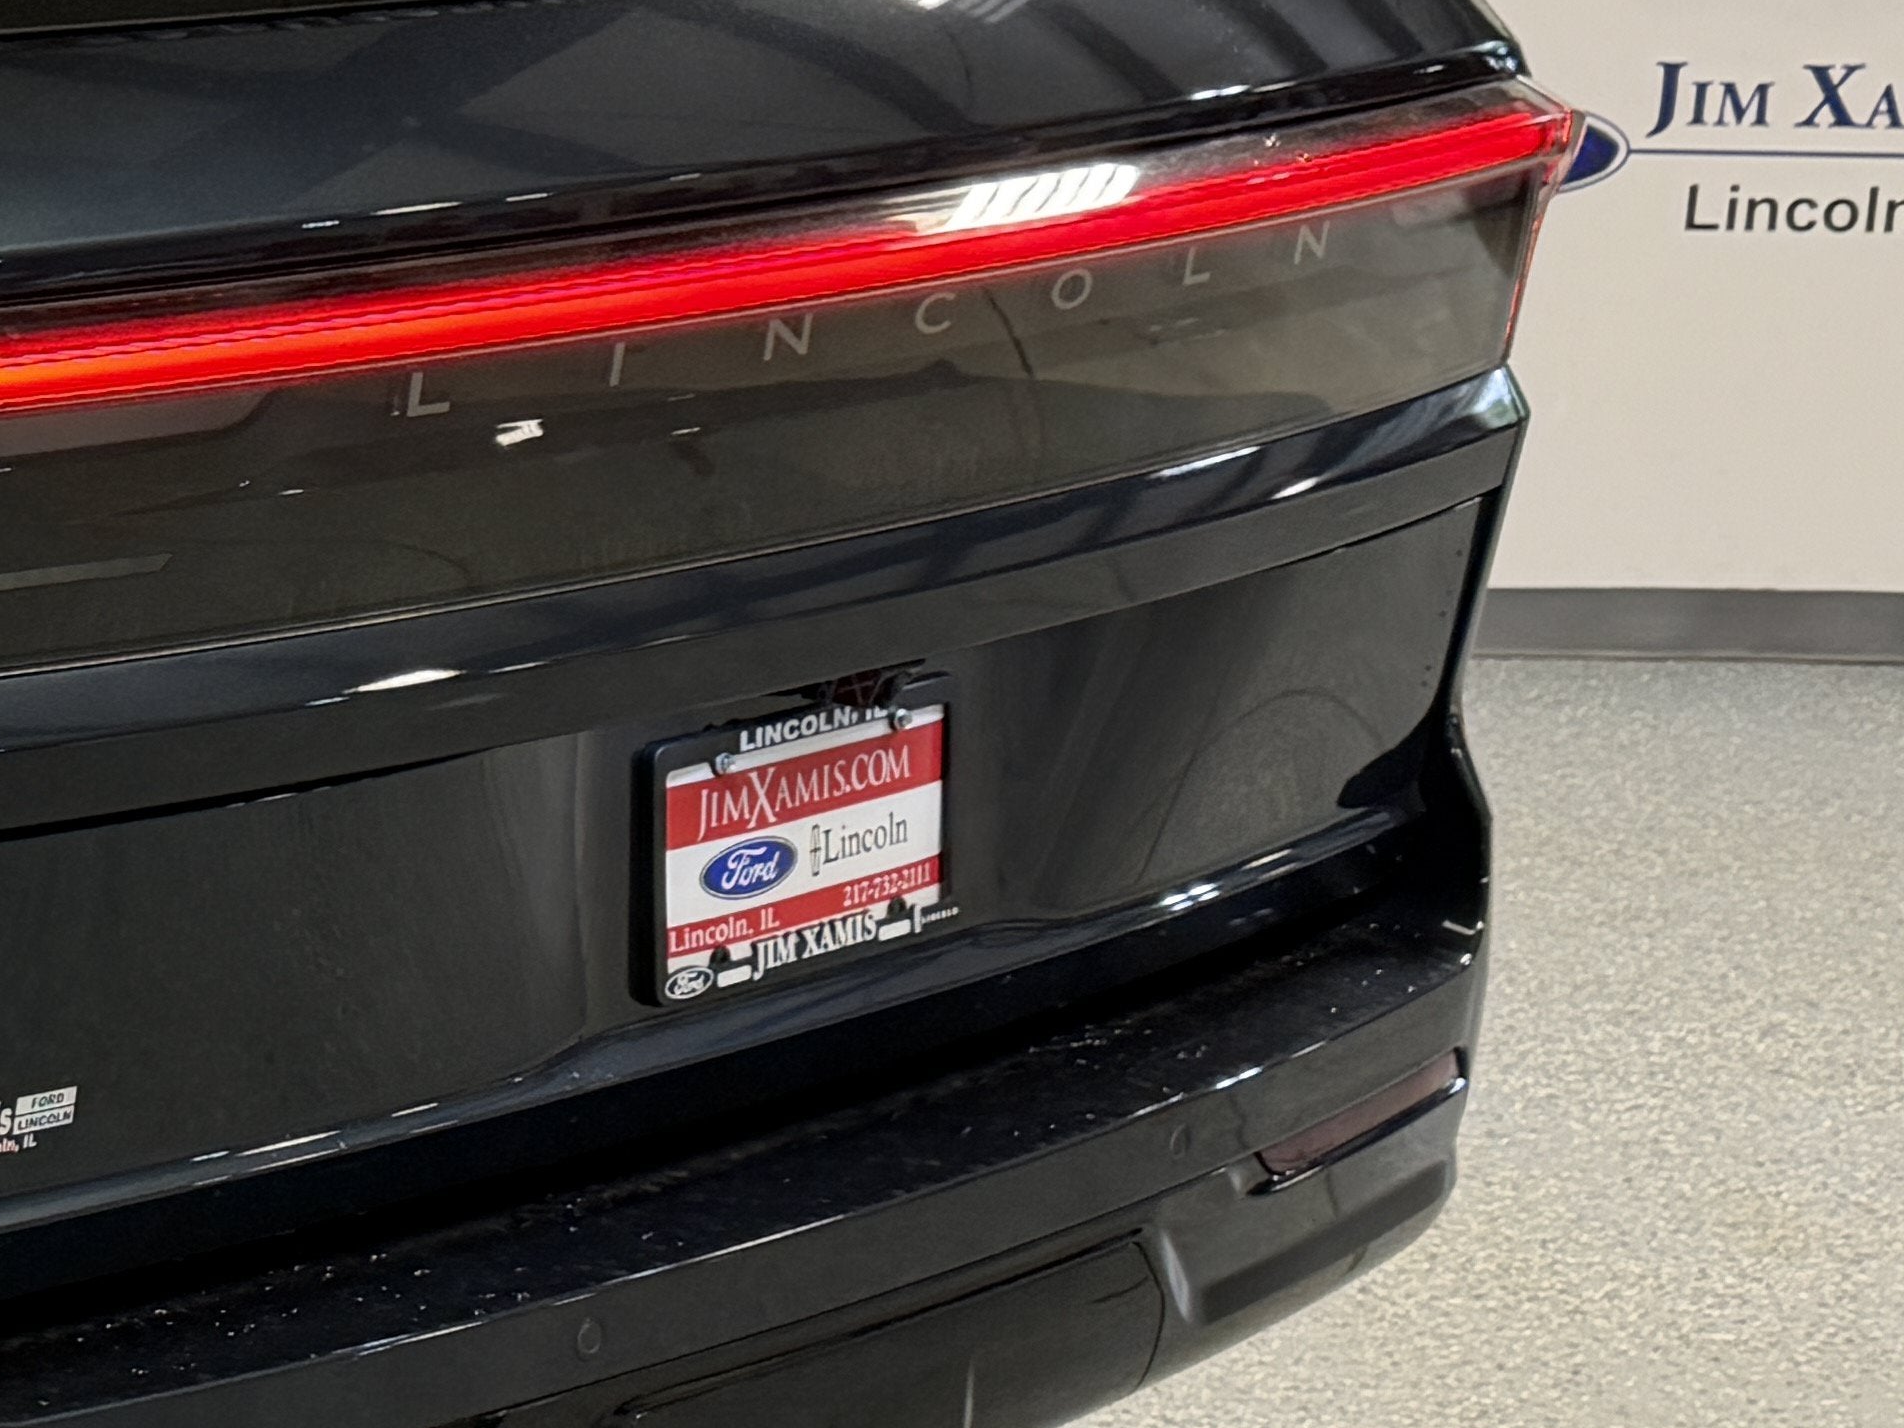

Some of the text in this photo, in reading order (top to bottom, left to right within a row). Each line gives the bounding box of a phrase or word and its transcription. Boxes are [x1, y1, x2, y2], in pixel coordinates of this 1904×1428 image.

[404, 222, 1335, 419] LINCOLN
[823, 812, 908, 864] Lincoln
[721, 845, 780, 889] Ford
[760, 907, 780, 931] IL
[752, 911, 877, 981] JIM XAMIS
[30, 1091, 65, 1109] FORD
[17, 1109, 73, 1131] LINCOLN
[23, 1134, 37, 1149] IL
